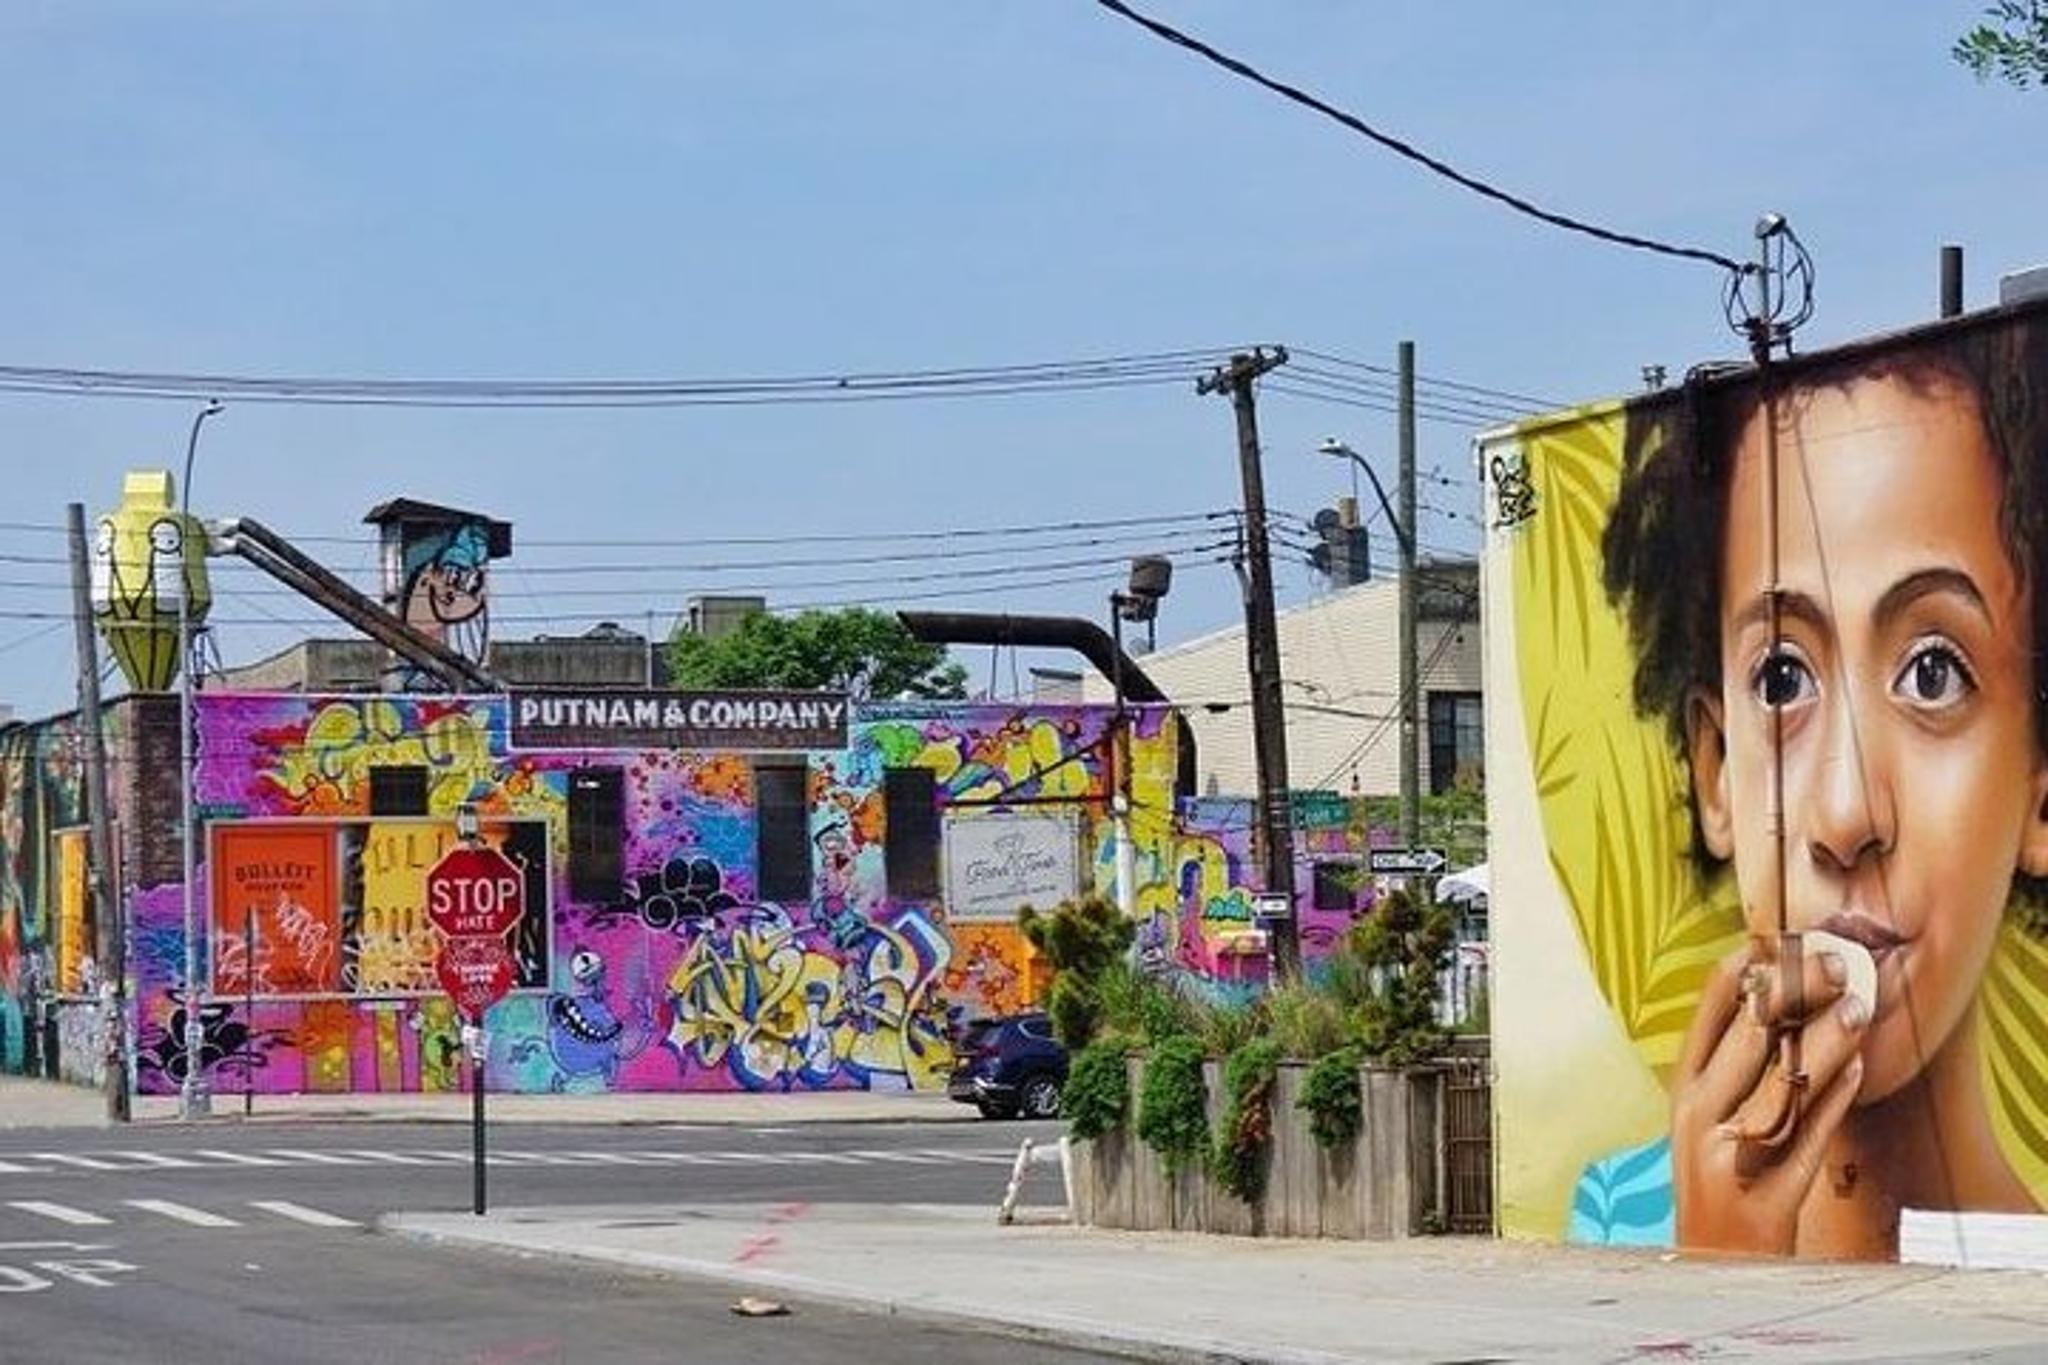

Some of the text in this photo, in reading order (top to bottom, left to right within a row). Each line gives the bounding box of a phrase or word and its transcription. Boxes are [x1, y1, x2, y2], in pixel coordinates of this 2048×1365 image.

[520, 698, 658, 727] PUTNAM
[690, 700, 843, 730] COMPANY
[431, 877, 518, 914] STOP
[456, 915, 495, 931] HATE
